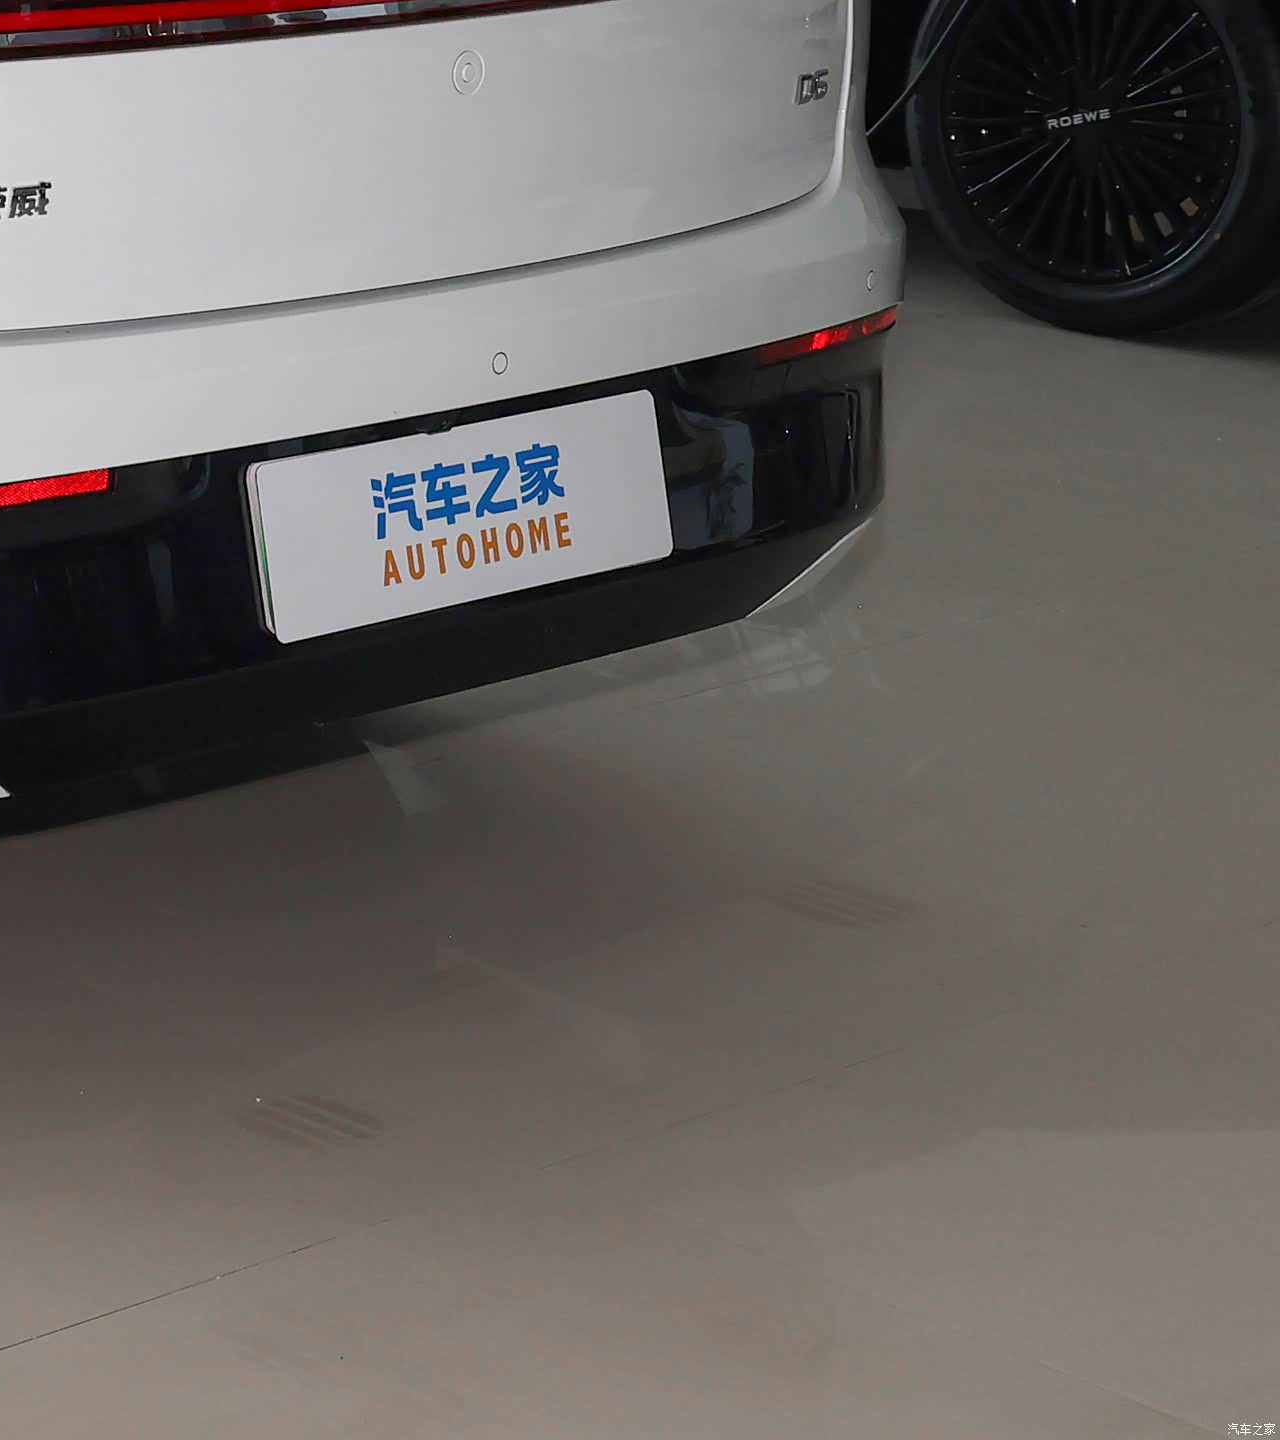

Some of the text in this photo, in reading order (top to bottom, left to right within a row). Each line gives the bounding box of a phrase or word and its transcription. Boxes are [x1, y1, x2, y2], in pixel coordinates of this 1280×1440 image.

[794, 68, 830, 106] D6
[1047, 108, 1112, 130] ROEWE
[370, 443, 565, 540] 汽车之家
[383, 512, 572, 586] AUTOHOME
